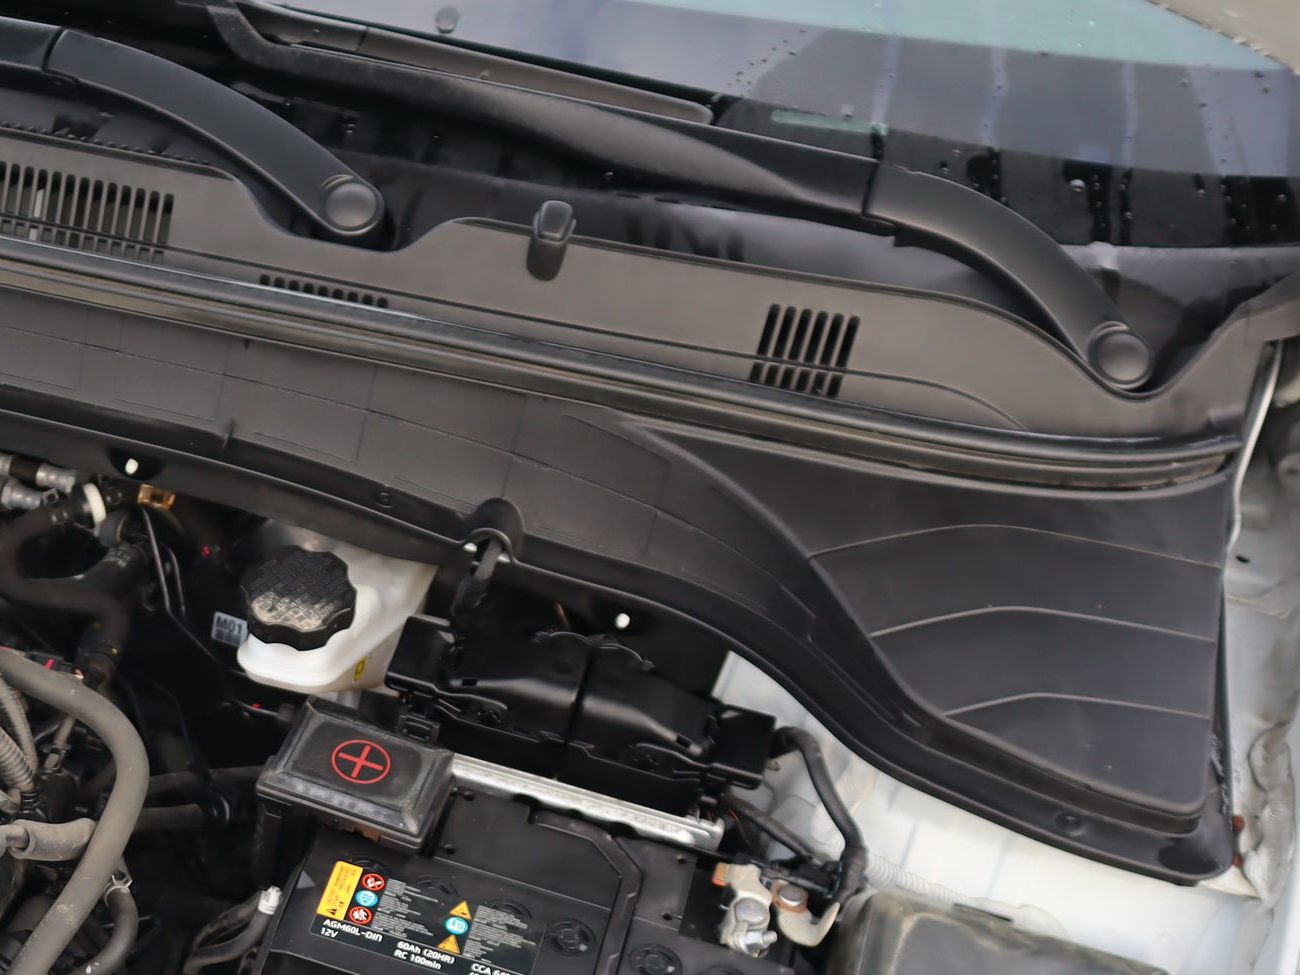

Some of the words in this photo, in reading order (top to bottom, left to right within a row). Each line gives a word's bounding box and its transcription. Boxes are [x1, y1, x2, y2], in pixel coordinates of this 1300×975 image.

[321, 927, 339, 938] 12V
[323, 919, 383, 942] AGM60L-DIN
[394, 949, 408, 960] RC
[410, 954, 442, 970] 100min
[397, 941, 421, 954] 60Ah
[422, 948, 455, 964] (20HR)
[471, 963, 491, 975] CCA
